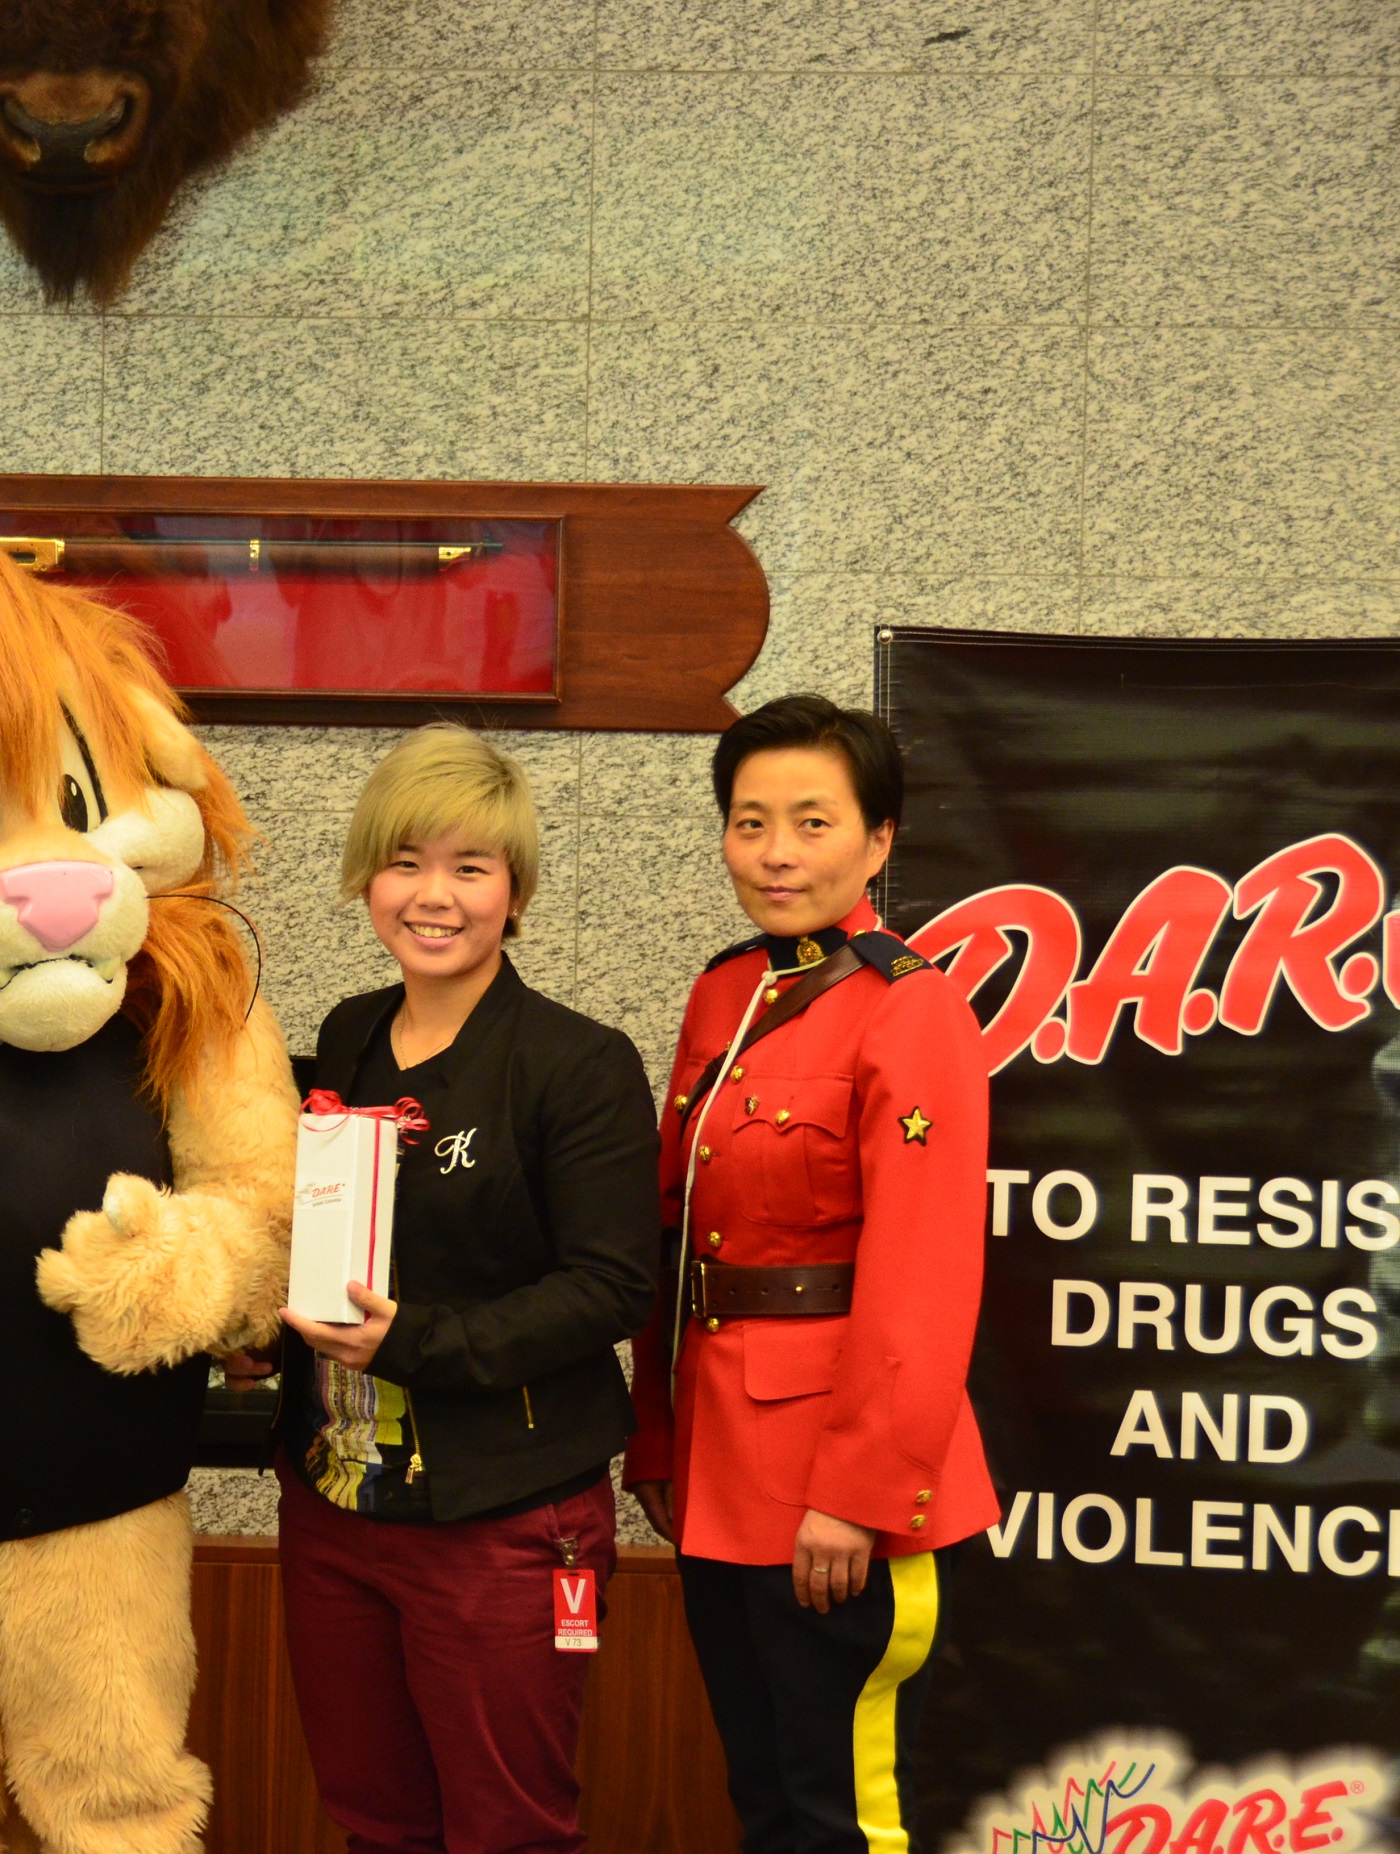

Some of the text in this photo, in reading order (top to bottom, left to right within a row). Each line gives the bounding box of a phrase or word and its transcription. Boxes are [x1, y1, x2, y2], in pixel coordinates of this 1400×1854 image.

[904, 832, 1400, 1078] D.A.R.
[986, 1169, 1098, 1241] TO
[1051, 1279, 1378, 1360] DRUGS
[1110, 1390, 1308, 1463] AND
[986, 1491, 1400, 1577] VIOLENC
[560, 1578, 586, 1614] V
[561, 1619, 589, 1627] ESCORT
[558, 1628, 593, 1637] REQUIRED
